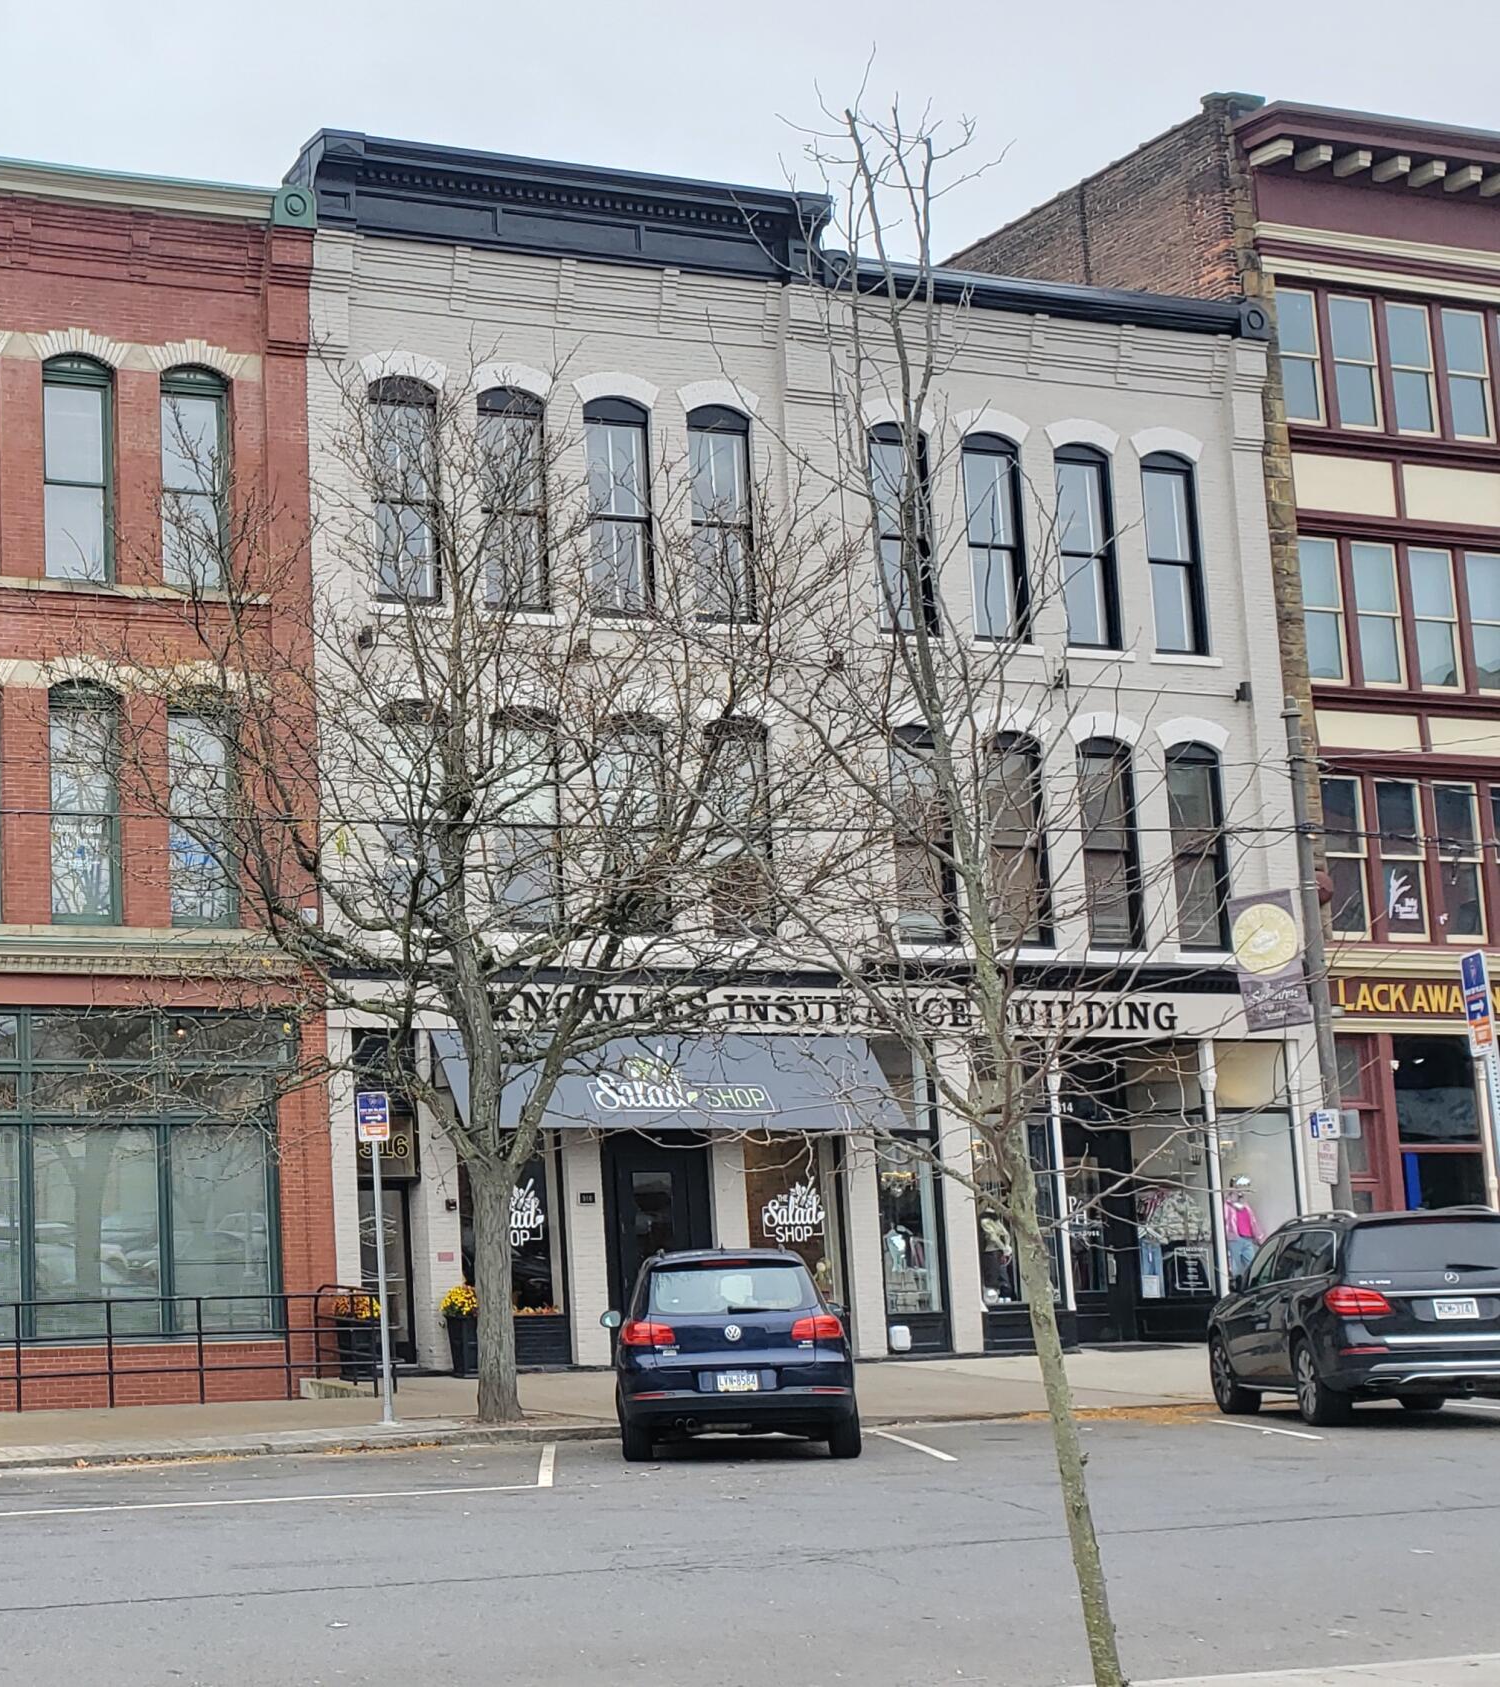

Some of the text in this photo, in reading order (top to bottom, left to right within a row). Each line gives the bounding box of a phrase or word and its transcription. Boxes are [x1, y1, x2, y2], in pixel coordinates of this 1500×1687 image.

[999, 1000, 1178, 1031] UILDING
[704, 1088, 765, 1109] SHOP
[764, 1196, 819, 1227] Salad
[775, 1226, 813, 1242] SHOP
